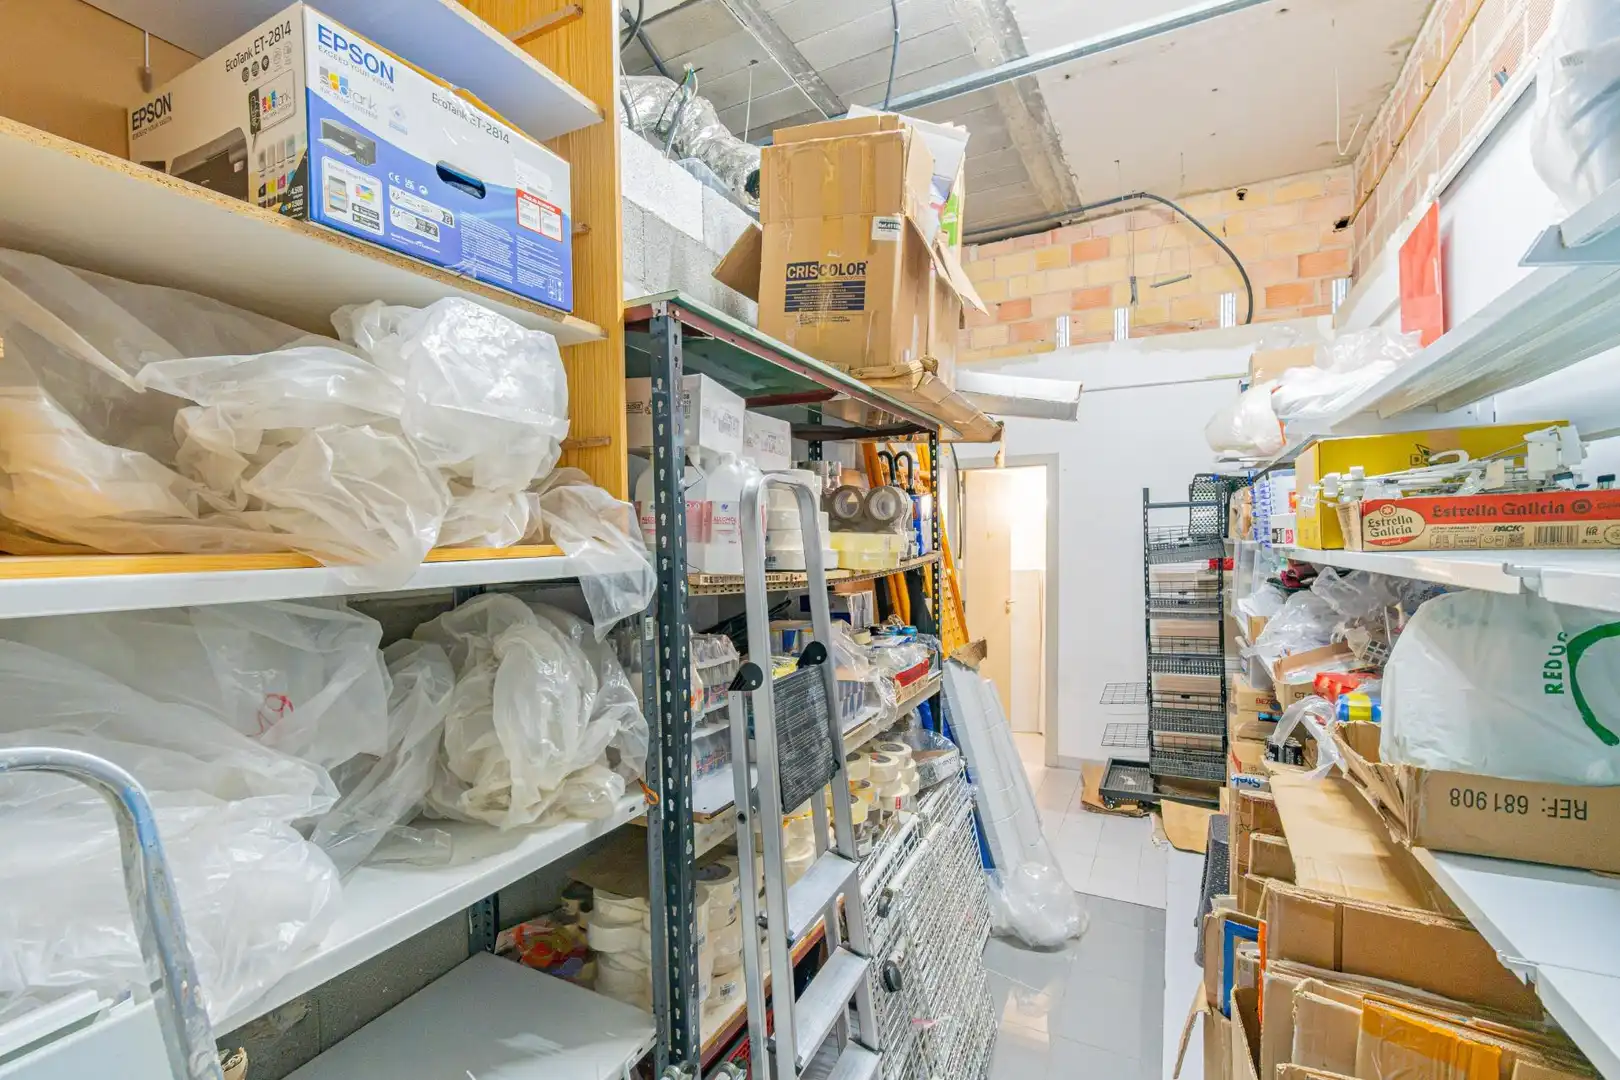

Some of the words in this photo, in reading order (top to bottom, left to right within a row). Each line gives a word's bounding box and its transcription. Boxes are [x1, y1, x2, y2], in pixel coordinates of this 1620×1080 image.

[225, 47, 253, 73] EcoTank
[253, 20, 291, 55] ET-2814
[318, 23, 394, 84] EPSON
[132, 92, 172, 131] EPSON
[432, 92, 468, 122] EcoTank
[469, 112, 510, 144] ET-2814
[787, 262, 866, 278] CRISCOLOR
[1432, 502, 1498, 518] Estrella
[1502, 500, 1565, 515] Galicia
[1368, 515, 1413, 528] Estrella
[1370, 525, 1412, 537] Galicia
[1450, 788, 1529, 814] 681908
[1542, 798, 1587, 820] REF:
